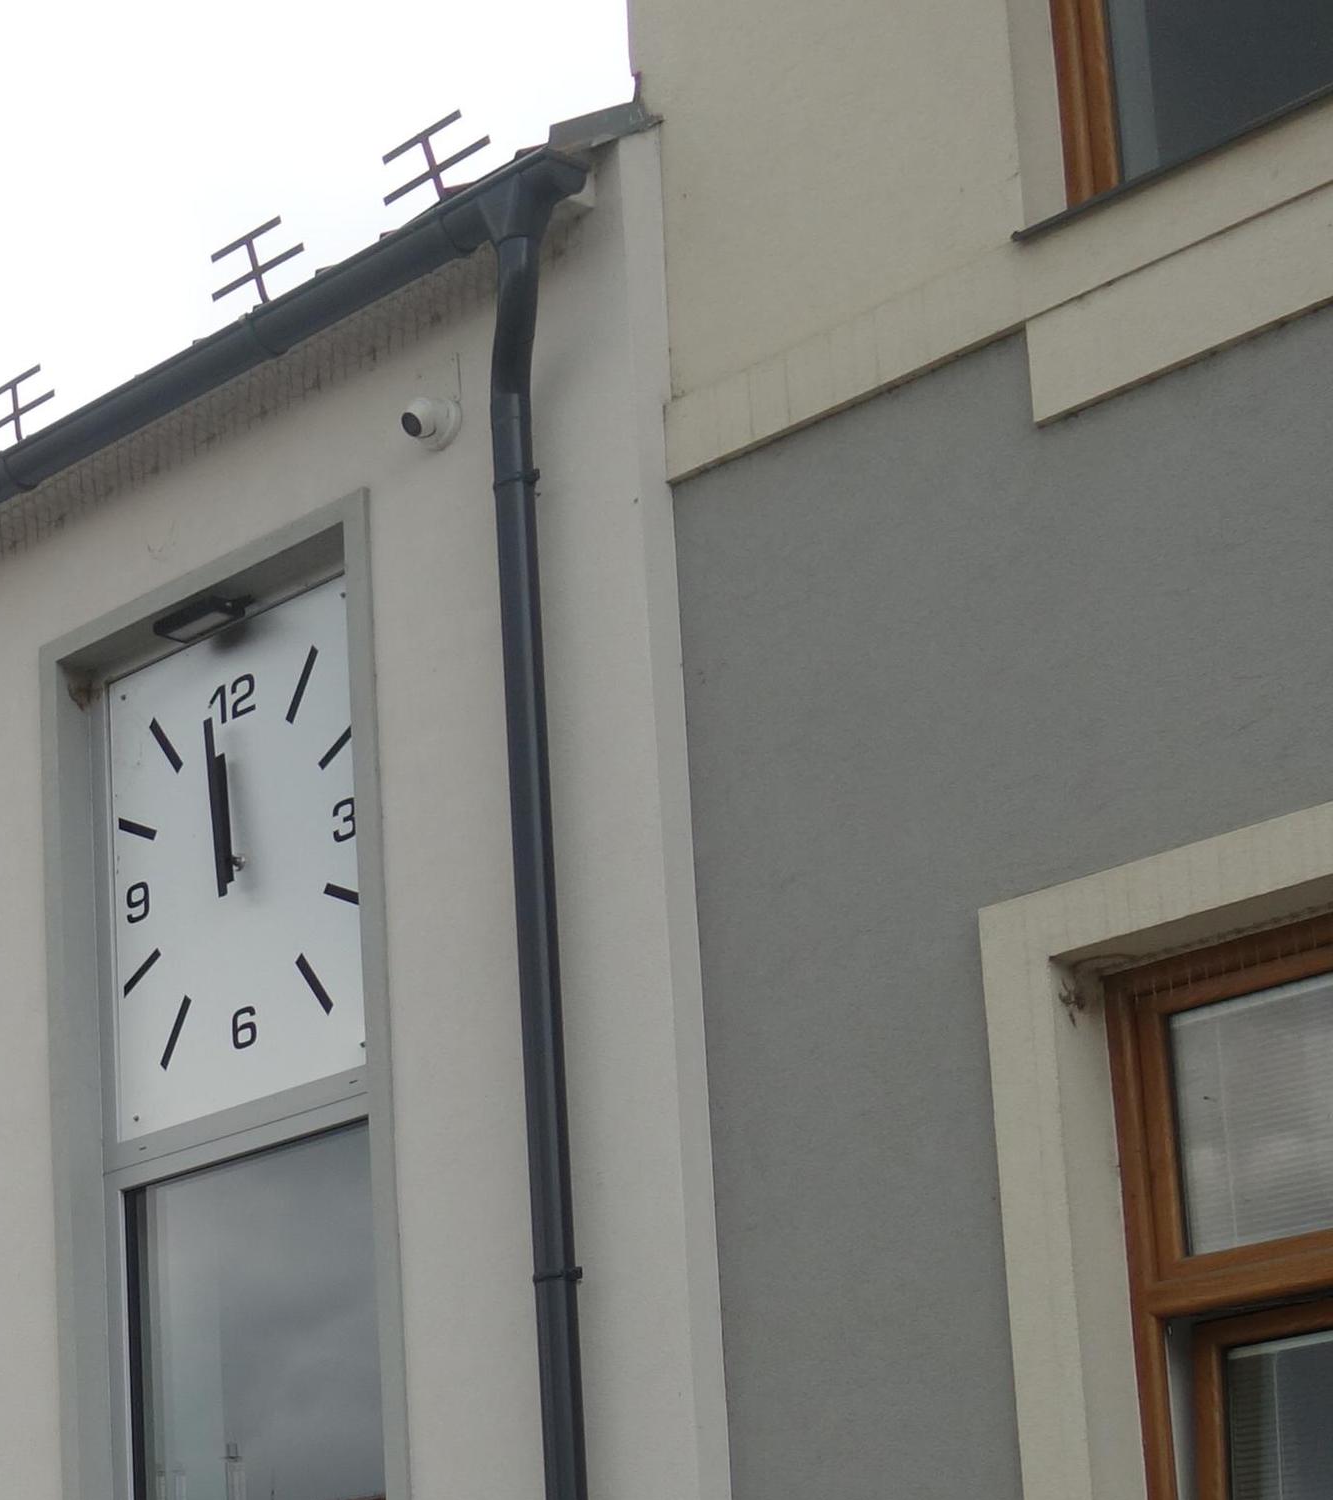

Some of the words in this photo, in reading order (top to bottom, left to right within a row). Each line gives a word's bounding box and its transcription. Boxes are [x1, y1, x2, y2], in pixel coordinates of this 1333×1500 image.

[208, 673, 257, 724] 12
[333, 797, 357, 843] 3
[126, 881, 150, 924] 9
[232, 1005, 258, 1050] 6
